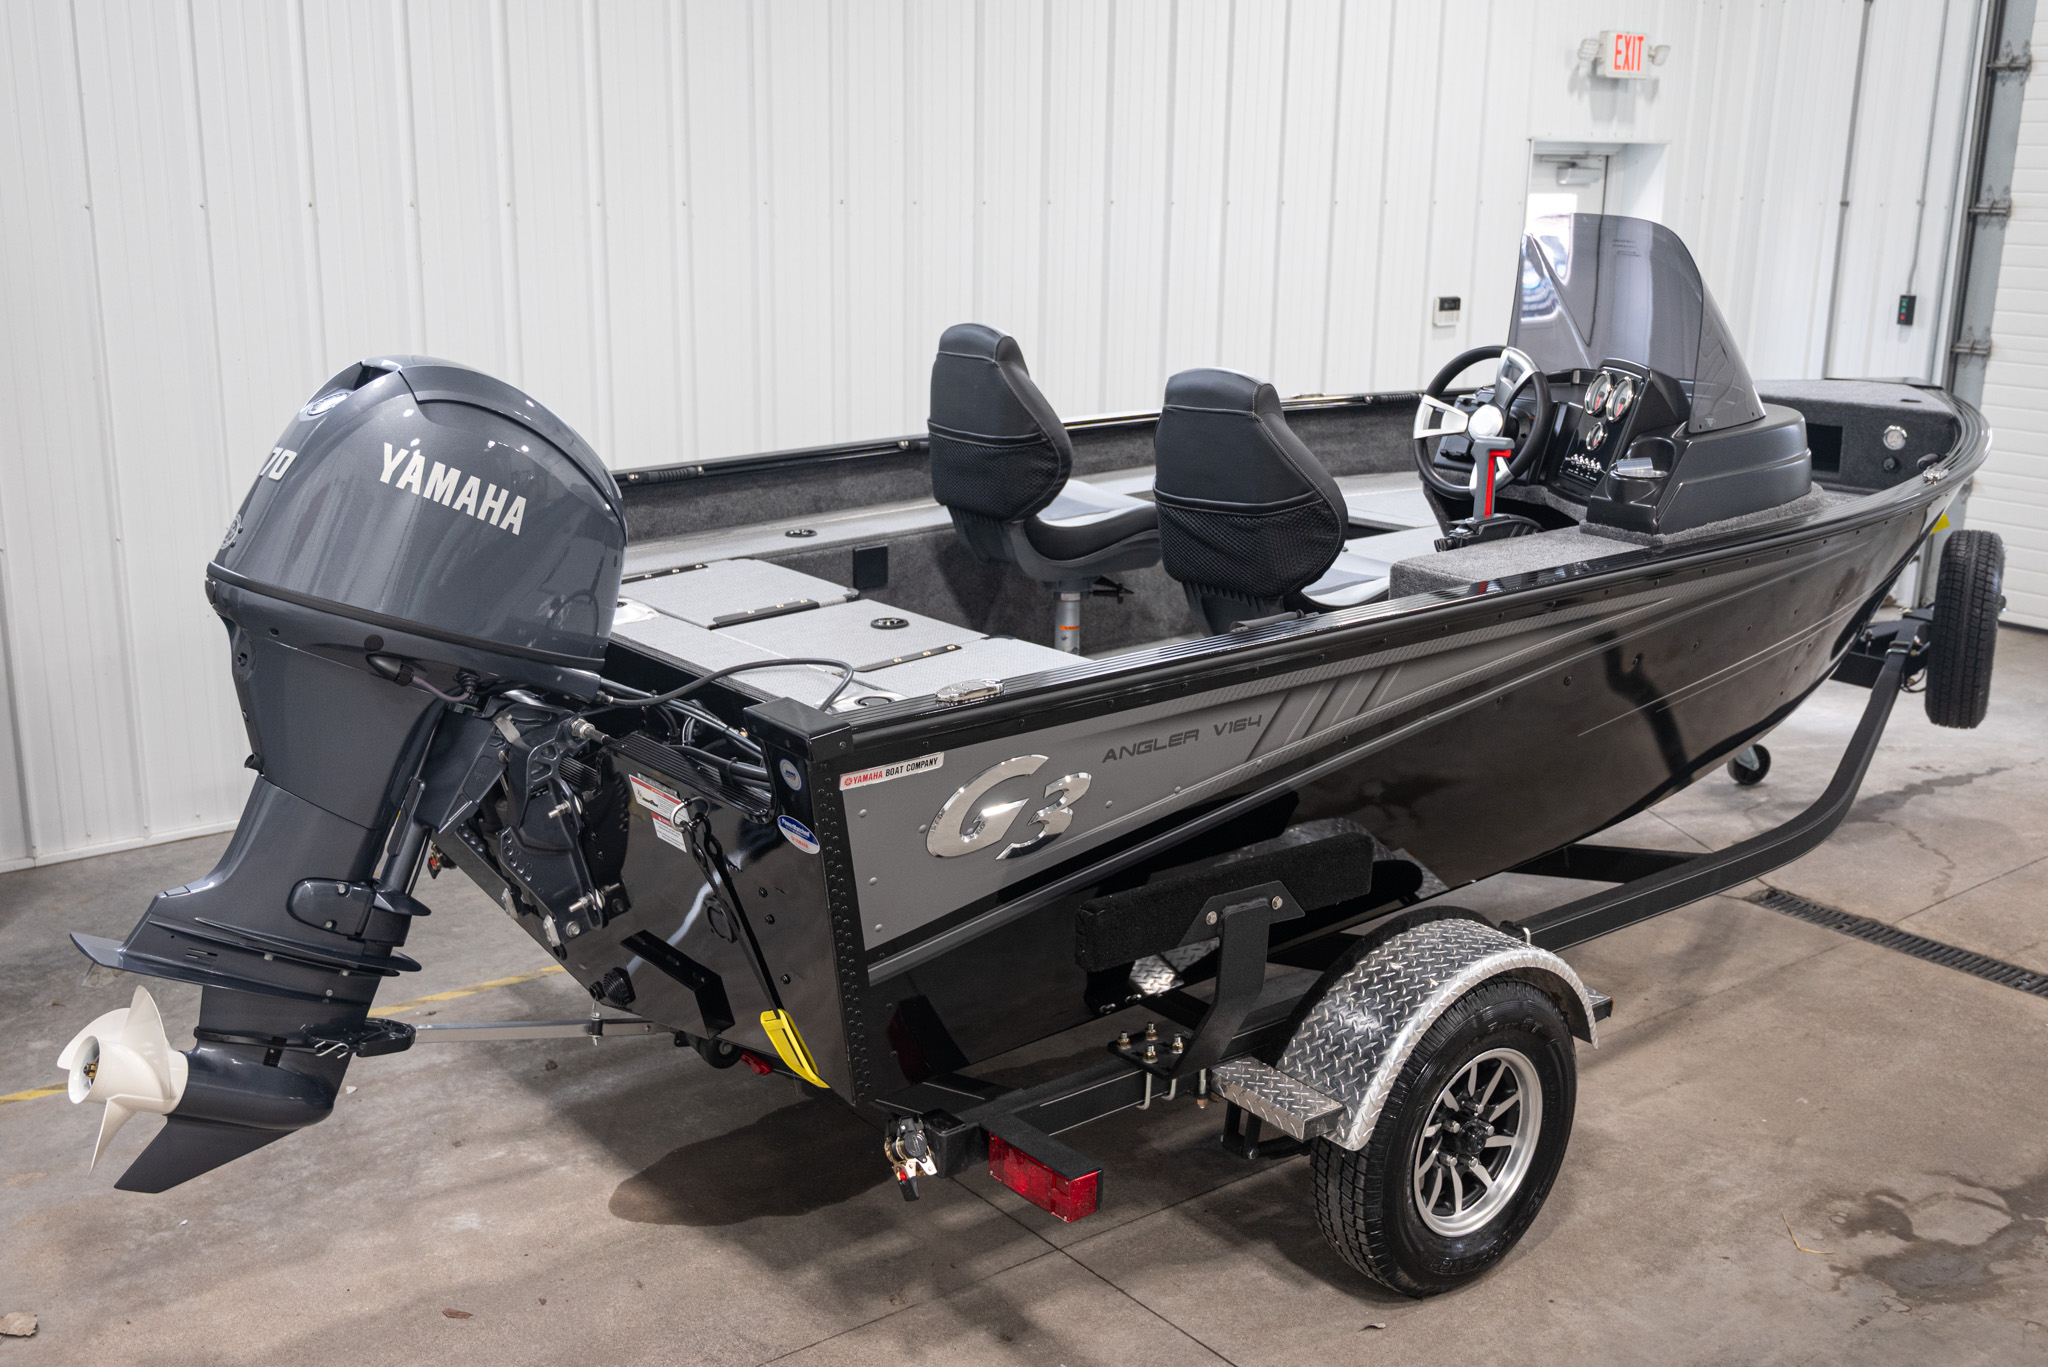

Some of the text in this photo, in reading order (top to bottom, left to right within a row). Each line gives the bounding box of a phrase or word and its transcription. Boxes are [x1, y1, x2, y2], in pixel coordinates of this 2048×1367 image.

[1614, 34, 1644, 72] EXIT
[259, 446, 298, 481] 70
[379, 441, 527, 536] YAMAHA
[1101, 714, 1262, 764] ANGLER V164
[853, 757, 938, 785] YAMAHA BOAT COMPANY
[926, 754, 1092, 860] G3
